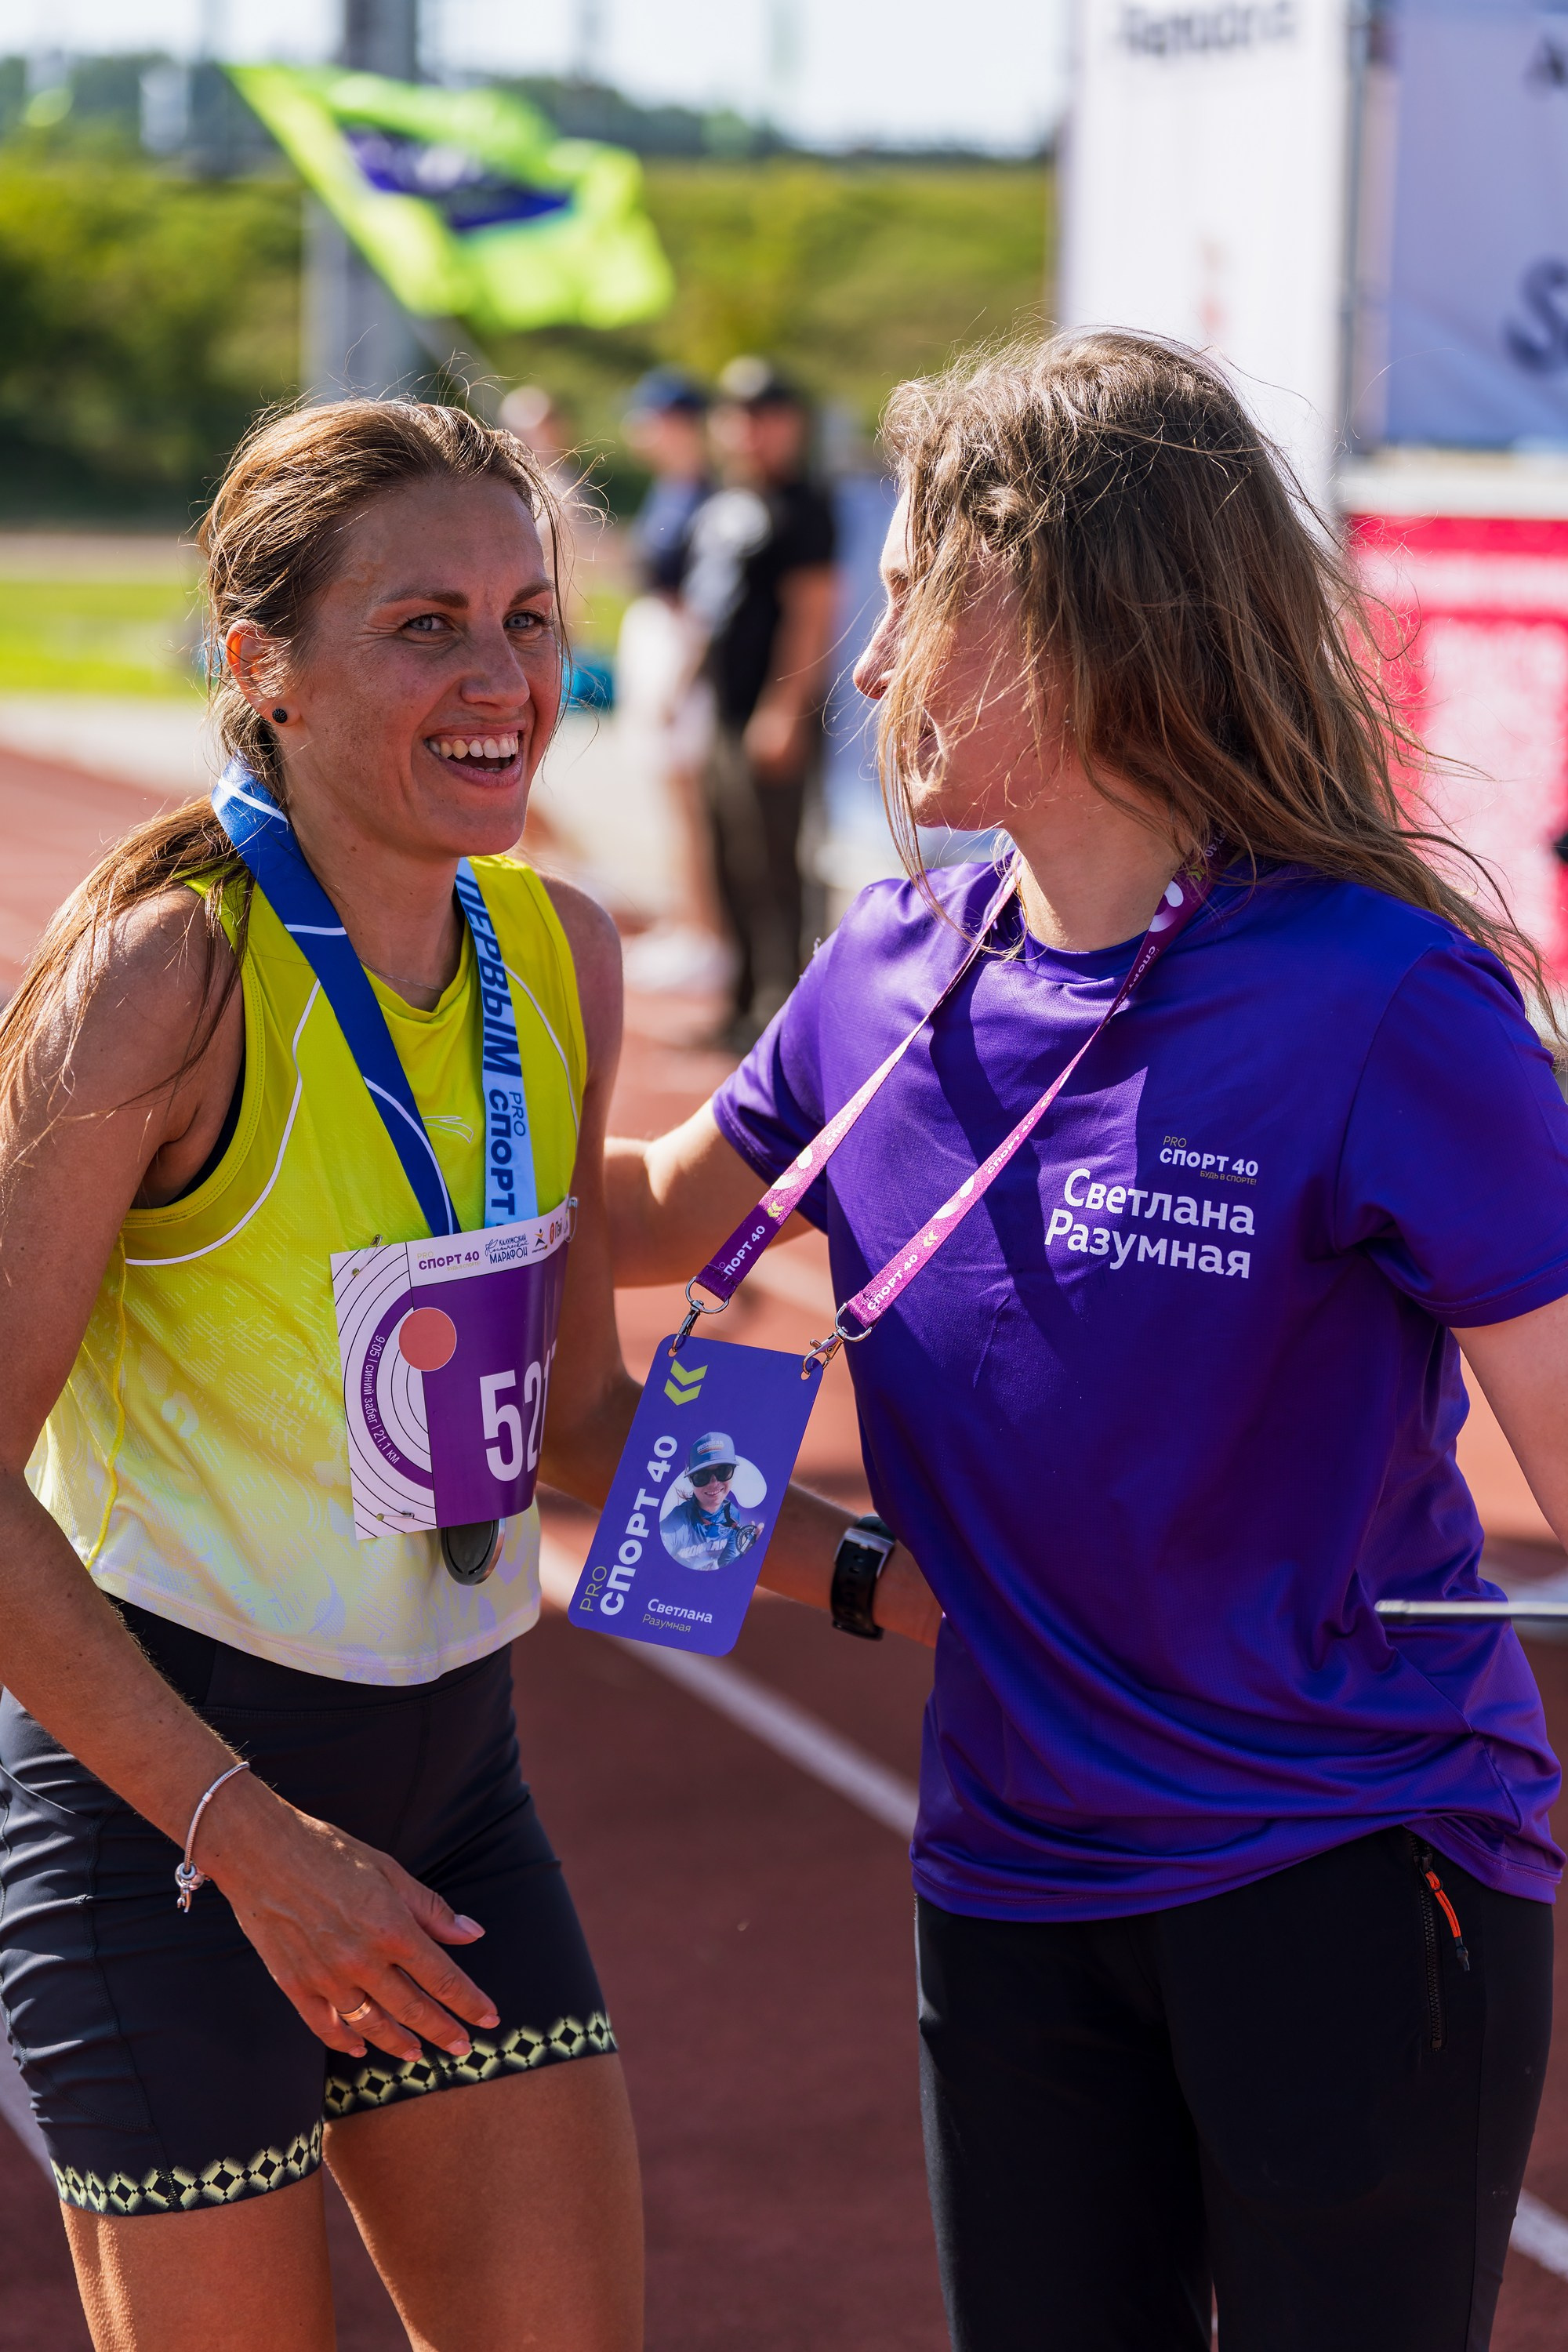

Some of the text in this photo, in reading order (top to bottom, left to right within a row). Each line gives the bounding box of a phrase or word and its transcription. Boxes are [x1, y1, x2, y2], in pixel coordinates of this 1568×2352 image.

[455, 874, 523, 1078] ПЕРВЫМ
[1128, 946, 1156, 990] СПОРТ
[508, 1091, 526, 1137] PRO
[489, 1088, 515, 1217] СПОРТ
[987, 1116, 1035, 1174] СПОРТ 40
[1160, 1147, 1258, 1177] СПОРТ 40
[1163, 1135, 1187, 1148] PRO
[1200, 1170, 1219, 1180] БУДЬ
[1226, 1174, 1257, 1185] СПОРТЕ!
[1064, 1167, 1255, 1236] Светлана
[416, 1250, 434, 1260] PRO
[489, 1246, 528, 1265] МАРАФОН
[751, 1225, 765, 1242] 40
[1044, 1208, 1251, 1279] Разумная
[419, 1250, 480, 1270] СПОРТ 40
[867, 1269, 903, 1310] СПОРТ
[903, 1254, 918, 1271] 40
[363, 1335, 400, 1465] 9:05 синий забег 21,1 км
[600, 1435, 678, 1617] СПОРТ 40
[579, 1566, 608, 1613] PRO
[647, 1599, 713, 1624] Светлана
[642, 1613, 691, 1633] Разумная
